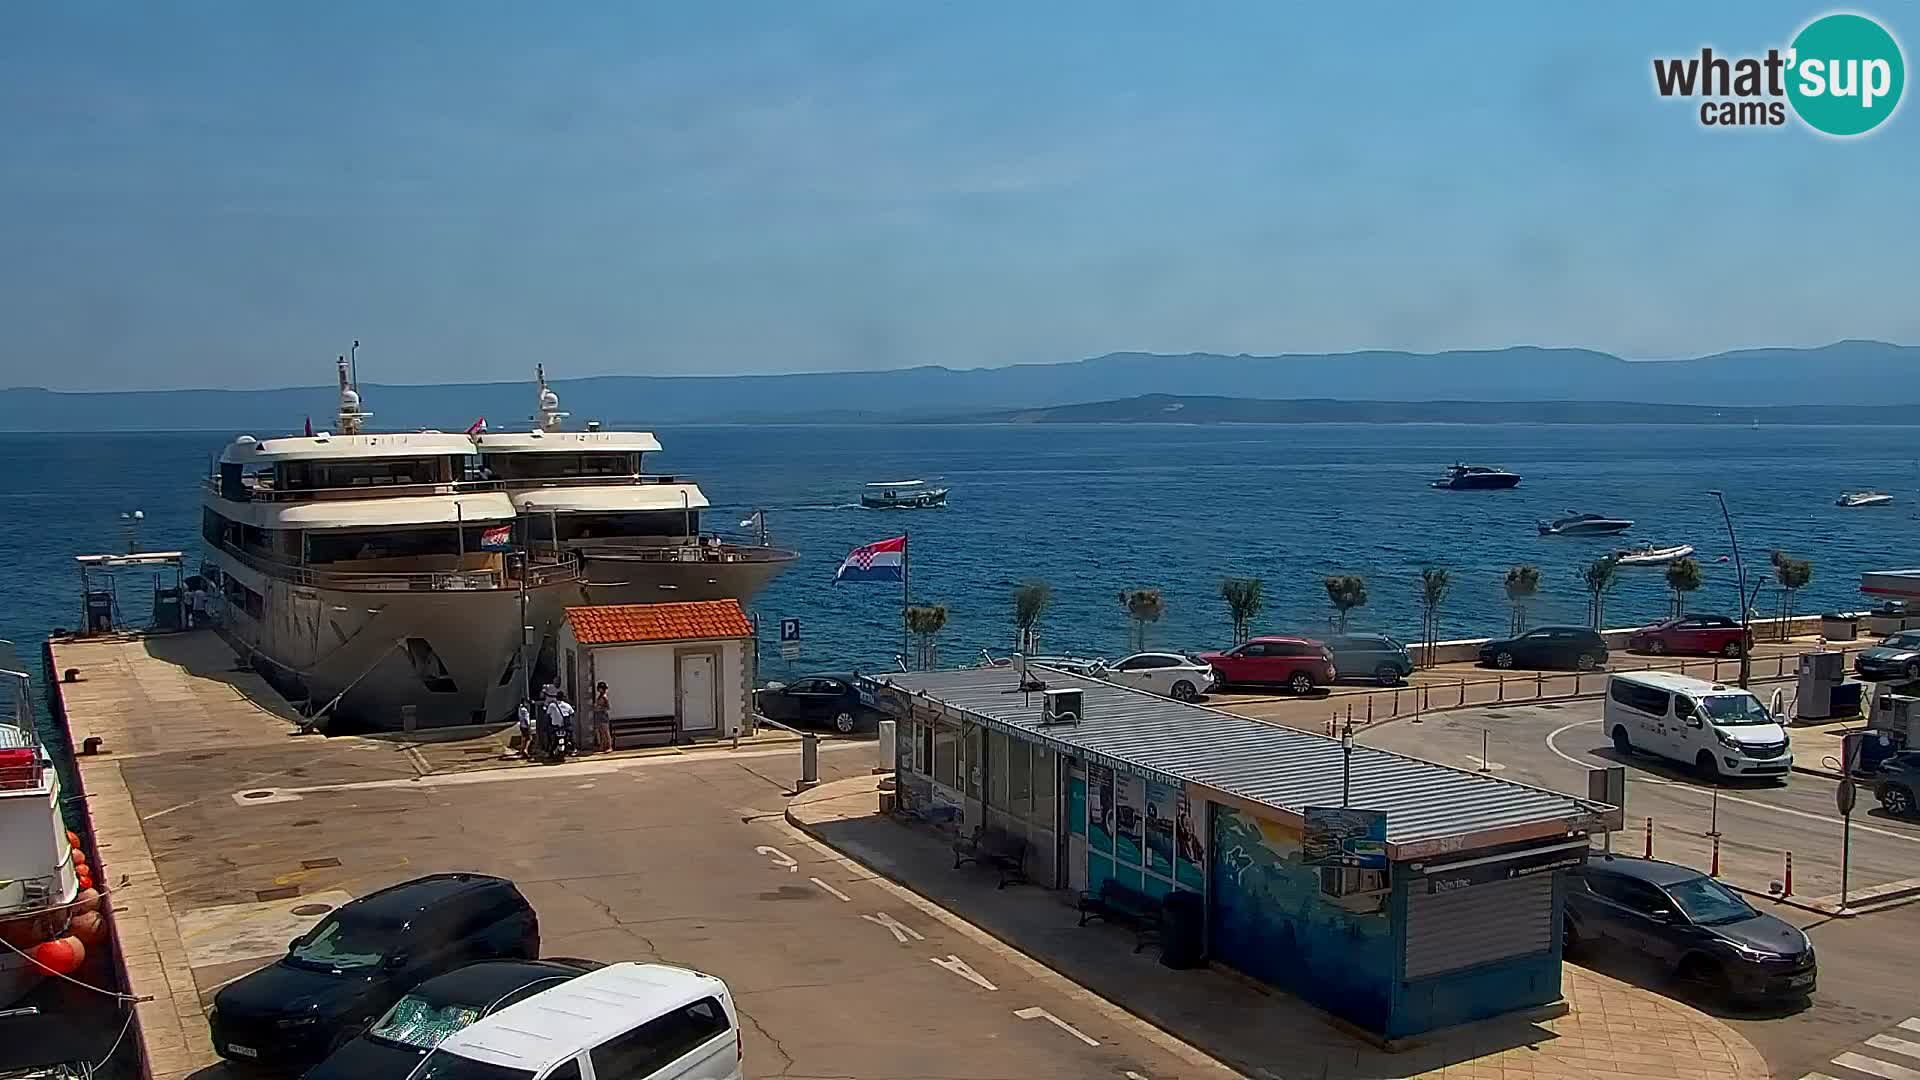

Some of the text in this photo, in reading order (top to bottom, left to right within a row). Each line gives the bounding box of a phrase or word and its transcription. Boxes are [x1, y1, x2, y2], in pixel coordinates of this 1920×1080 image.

[784, 621, 796, 639] P
[1083, 750, 1098, 765] BUS
[1098, 754, 1128, 773] STATION
[1130, 763, 1155, 780] TICKET
[1156, 772, 1182, 789] OFFICE
